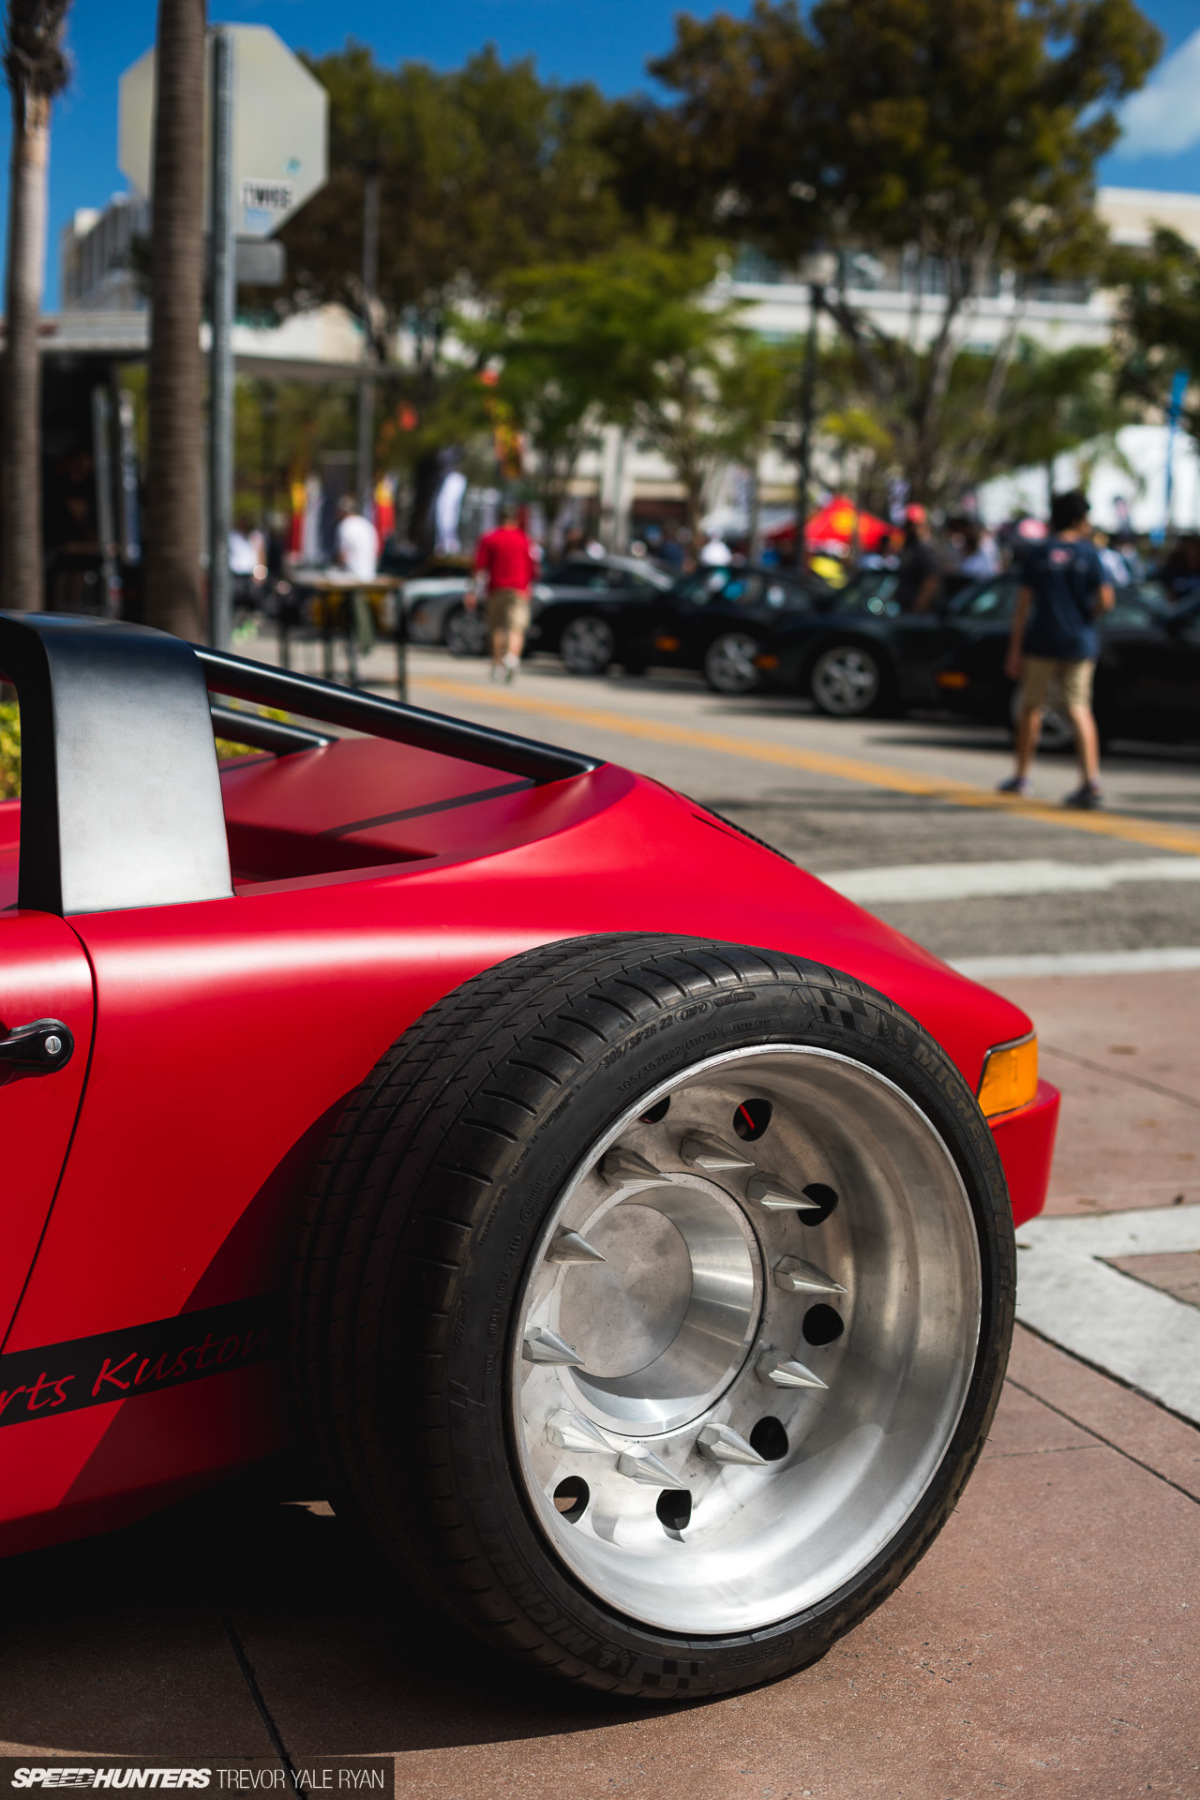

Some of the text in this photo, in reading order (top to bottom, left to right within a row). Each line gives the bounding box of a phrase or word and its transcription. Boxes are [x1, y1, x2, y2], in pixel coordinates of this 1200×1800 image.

[659, 1014, 674, 1032] 22
[911, 1040, 1005, 1199] MICHELIN
[510, 1146, 532, 1178] TRACTION
